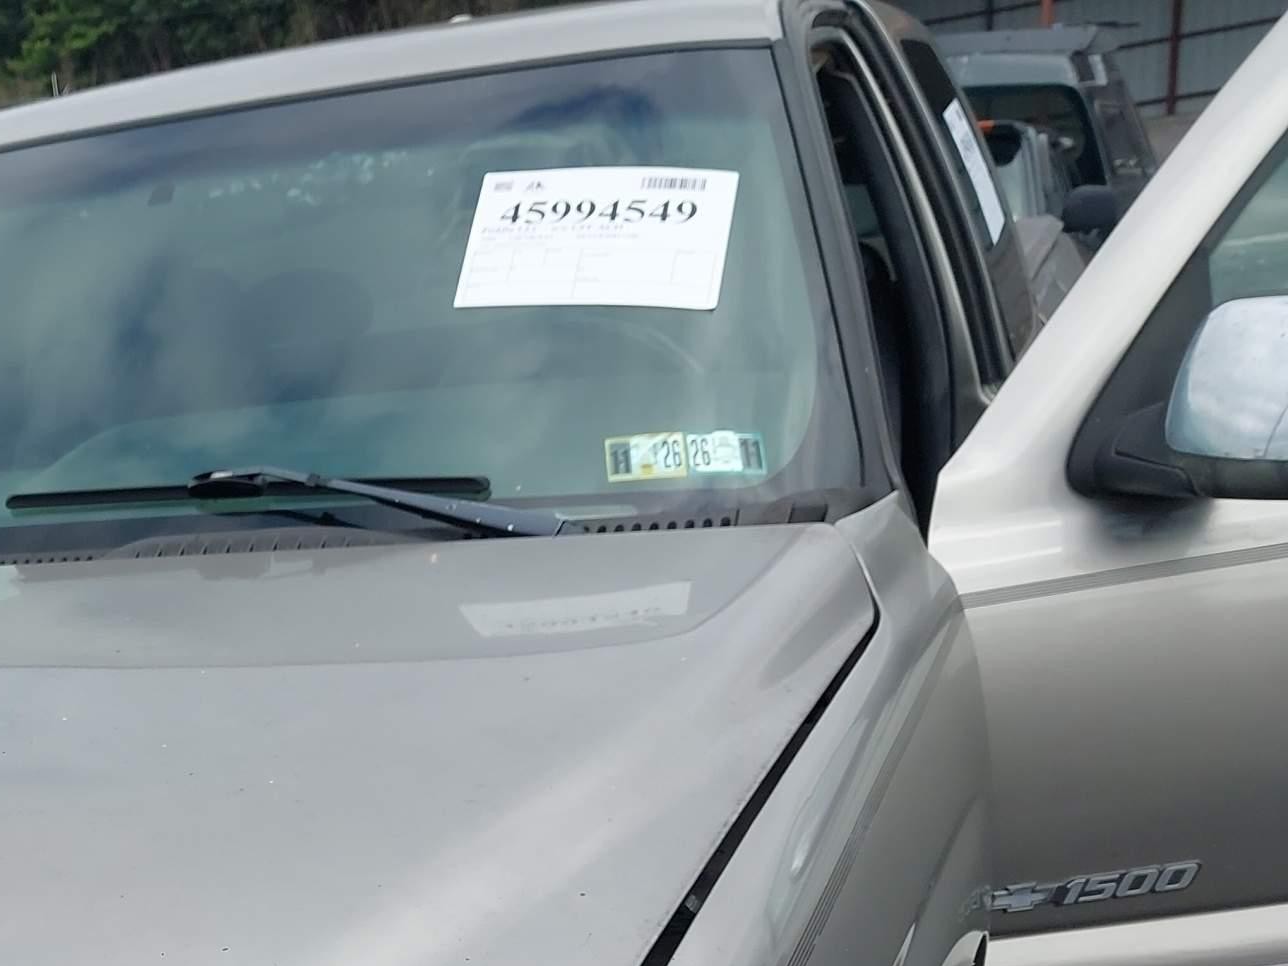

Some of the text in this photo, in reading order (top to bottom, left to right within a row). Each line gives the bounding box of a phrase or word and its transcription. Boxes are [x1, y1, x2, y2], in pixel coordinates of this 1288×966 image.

[501, 198, 698, 226] 45994549
[662, 440, 682, 469] 26
[690, 438, 711, 467] 26
[1062, 859, 1201, 906] 1500
